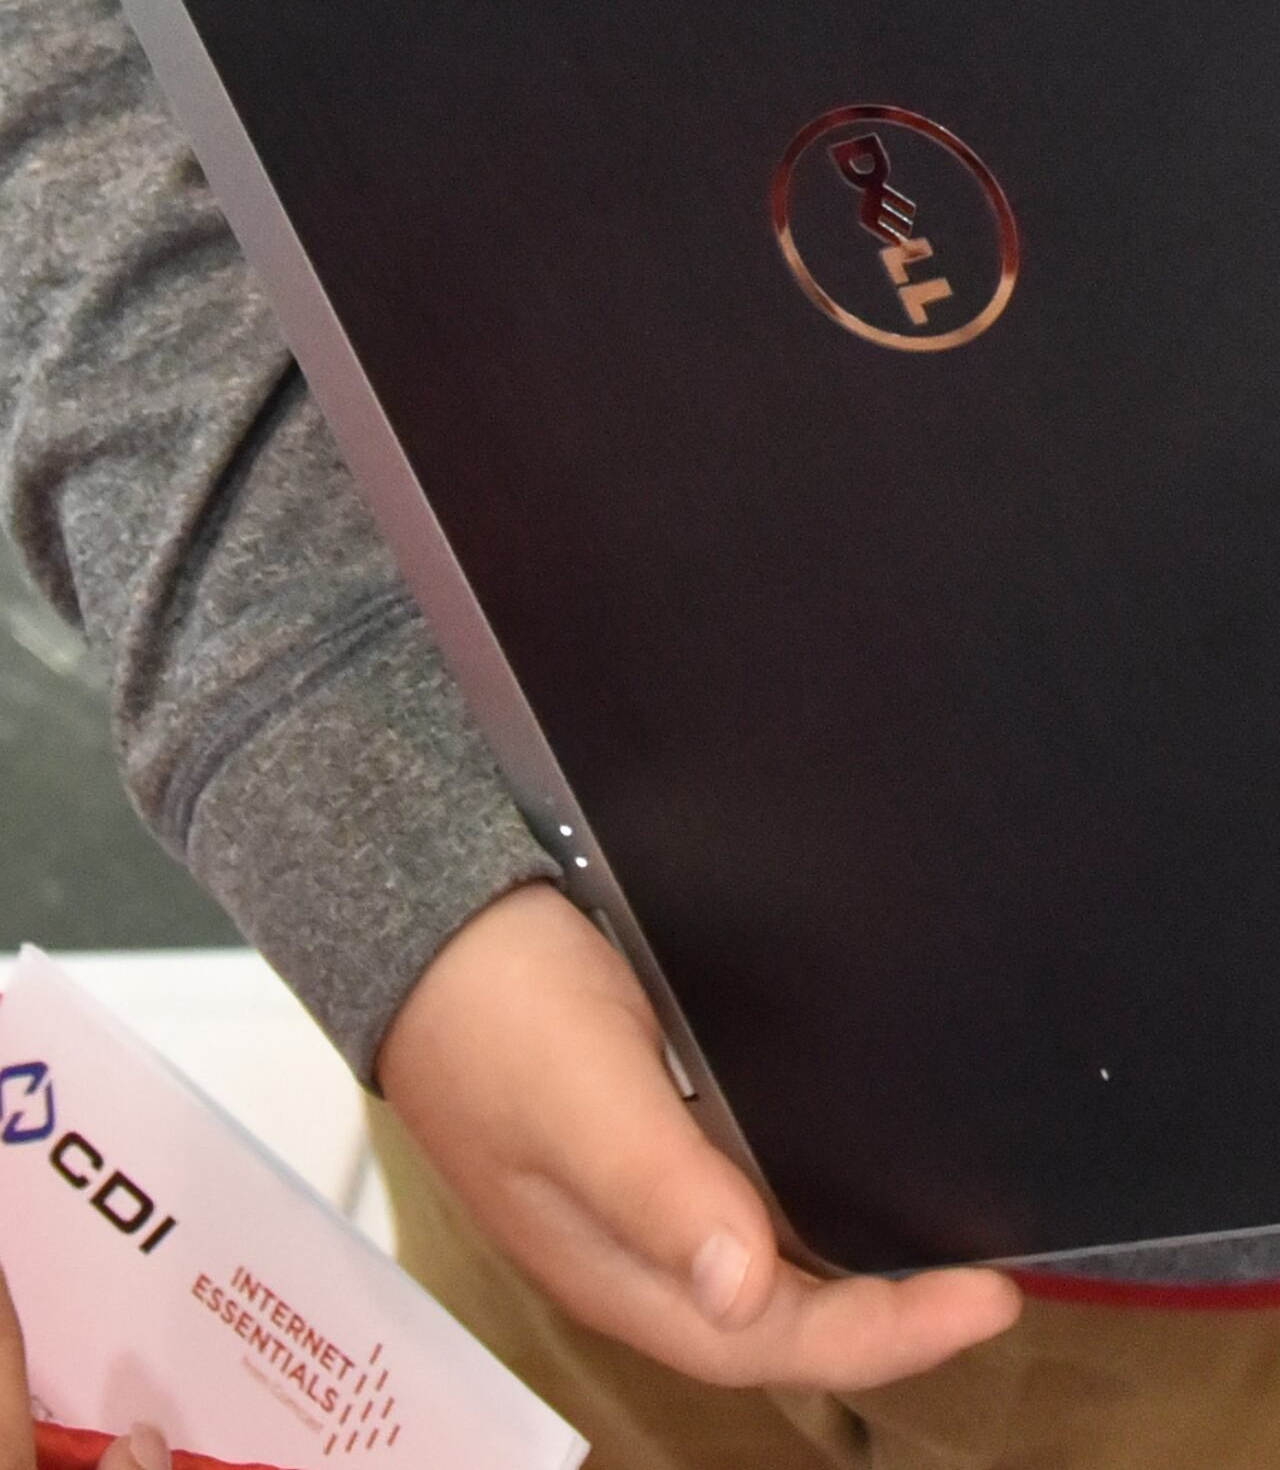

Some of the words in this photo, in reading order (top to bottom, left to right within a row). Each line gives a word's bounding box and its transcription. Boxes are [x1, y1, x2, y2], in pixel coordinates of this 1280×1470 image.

[827, 132, 954, 326] DELL
[49, 1130, 178, 1255] CDI
[191, 1273, 339, 1413] ESSENTIALS
[230, 1265, 355, 1381] INTERNET
